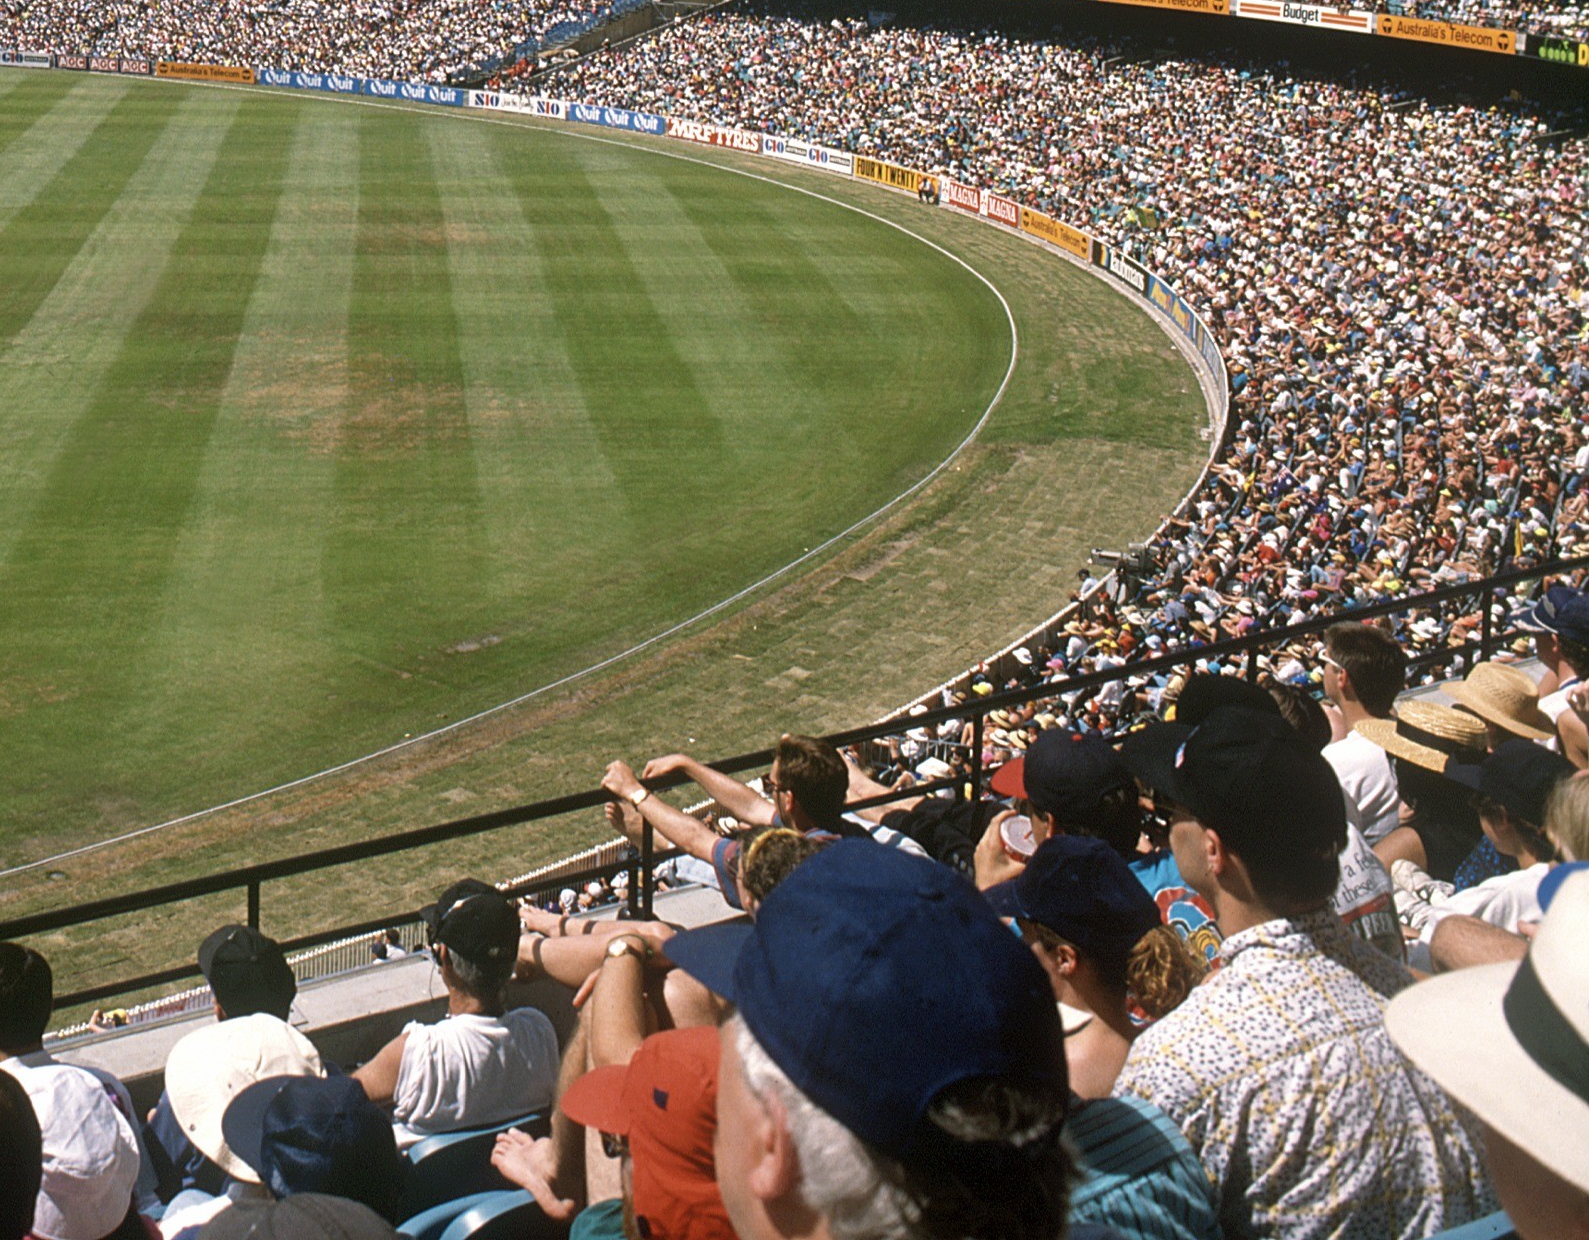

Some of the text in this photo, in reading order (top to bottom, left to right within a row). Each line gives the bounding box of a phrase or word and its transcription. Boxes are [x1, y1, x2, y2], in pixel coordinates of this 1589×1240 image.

[1282, 3, 1319, 23] Budget
[1396, 20, 1493, 47] Australia's Telecom
[170, 66, 240, 78] Australia's Telecom
[265, 70, 291, 86] Quit
[296, 73, 322, 88] Quit
[327, 75, 354, 92] Quit
[370, 79, 396, 96] Quit
[401, 83, 426, 102] Quit
[429, 86, 456, 103] Quit
[575, 103, 601, 121] Quit
[605, 109, 629, 126] Quit
[633, 113, 658, 131] Quit
[668, 119, 759, 153] MRF TYRES
[765, 138, 784, 154] GIO
[809, 147, 828, 164] GIO
[884, 164, 916, 189] TWENTY
[950, 182, 979, 209] MAGNA
[988, 195, 1017, 223] MAGNA
[1030, 216, 1081, 248] Australia's Telecom
